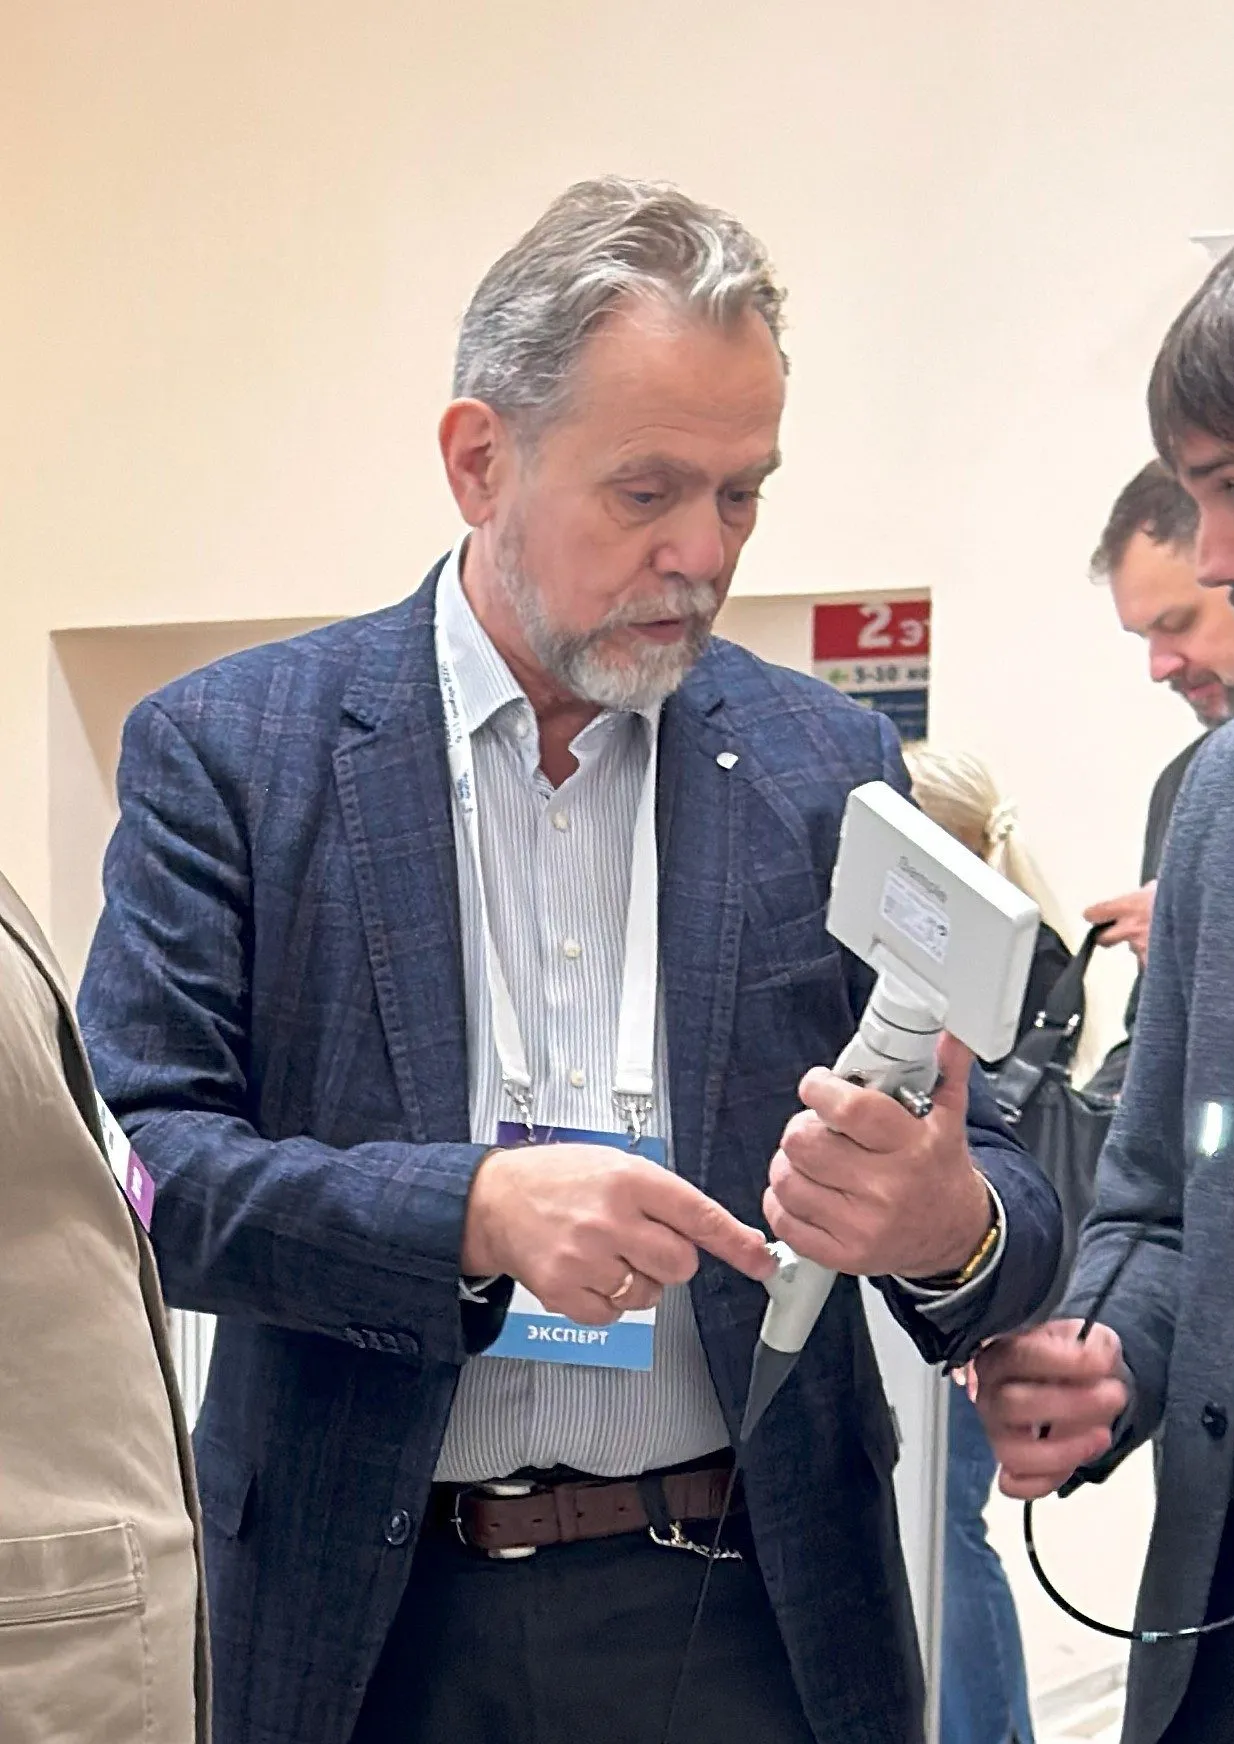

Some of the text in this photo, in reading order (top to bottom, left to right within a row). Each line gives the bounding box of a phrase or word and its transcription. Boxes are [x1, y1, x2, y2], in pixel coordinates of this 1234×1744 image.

[857, 604, 931, 649] 2 э
[528, 1325, 609, 1346] ЭКСПЕРТ
